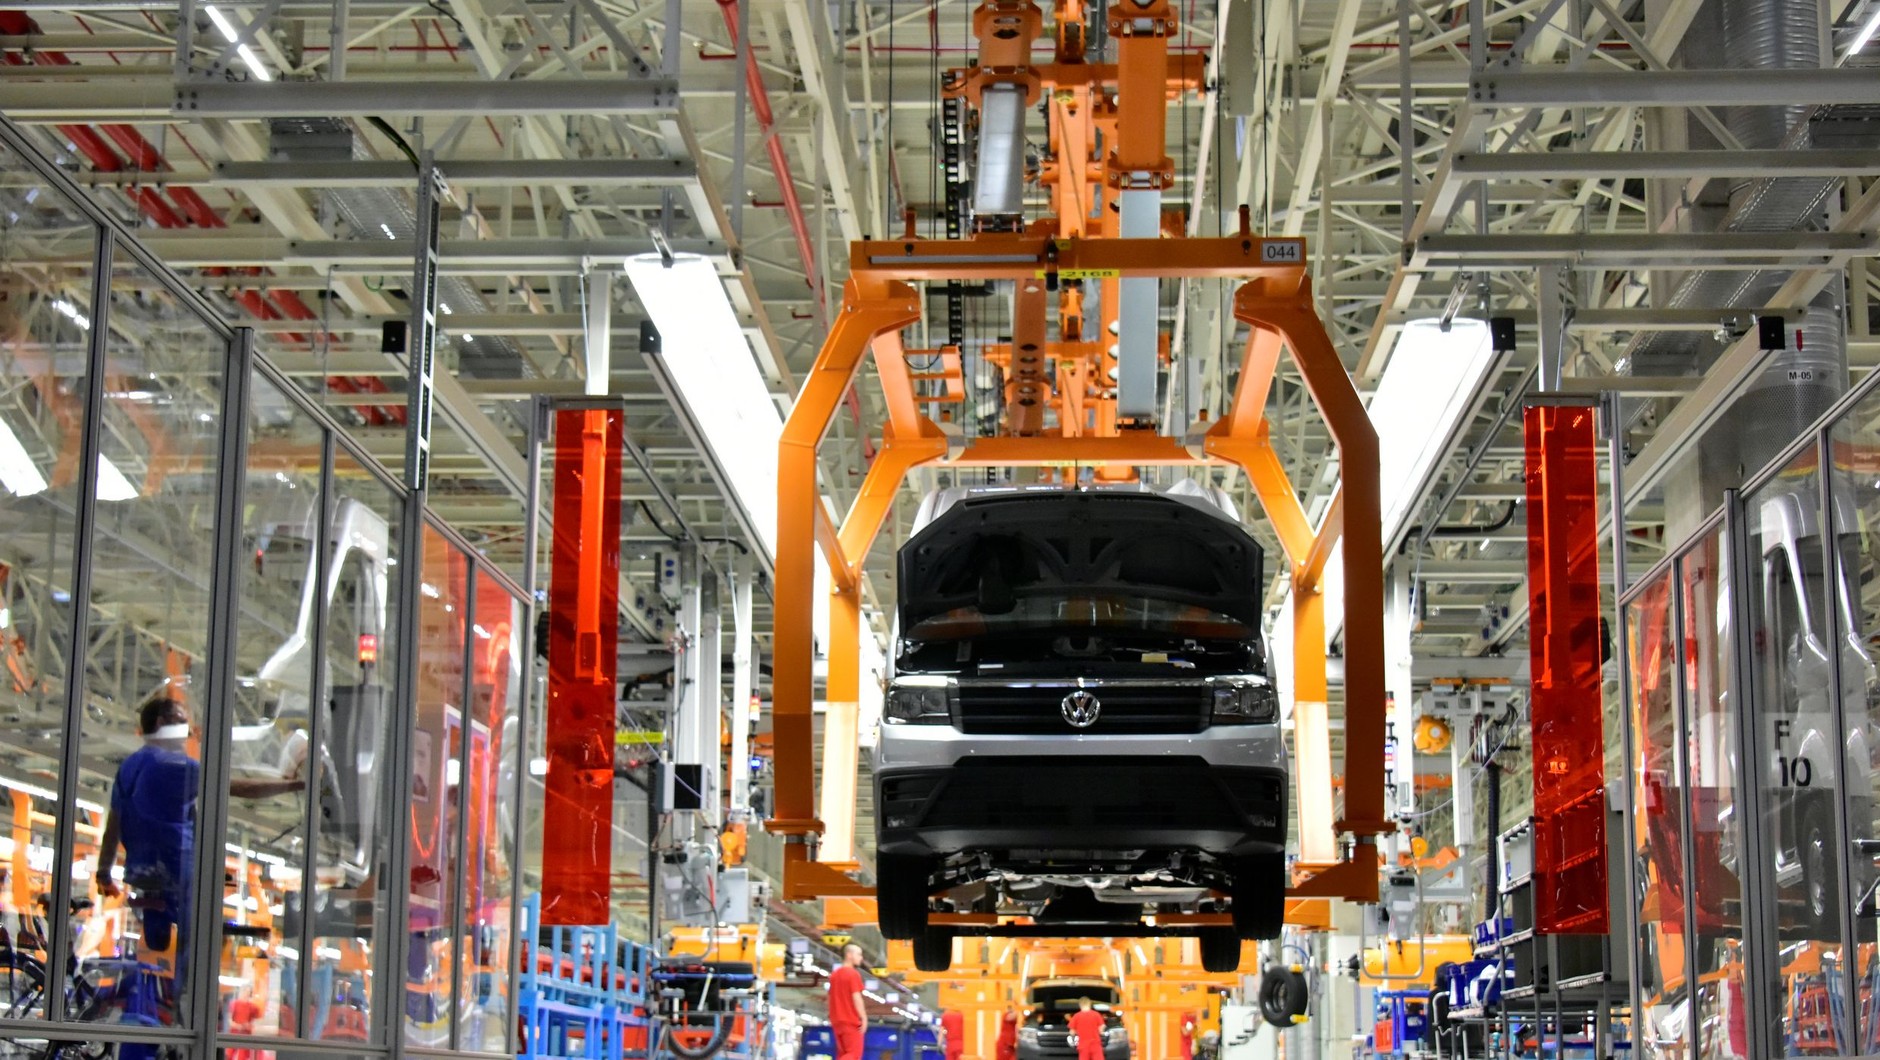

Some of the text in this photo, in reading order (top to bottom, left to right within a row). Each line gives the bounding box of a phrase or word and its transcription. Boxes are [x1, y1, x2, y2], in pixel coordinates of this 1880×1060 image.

[1266, 245, 1295, 259] 044
[1788, 371, 1812, 380] M-05
[1061, 691, 1100, 727] VW
[1773, 719, 1790, 750] F
[1778, 756, 1812, 787] 10
